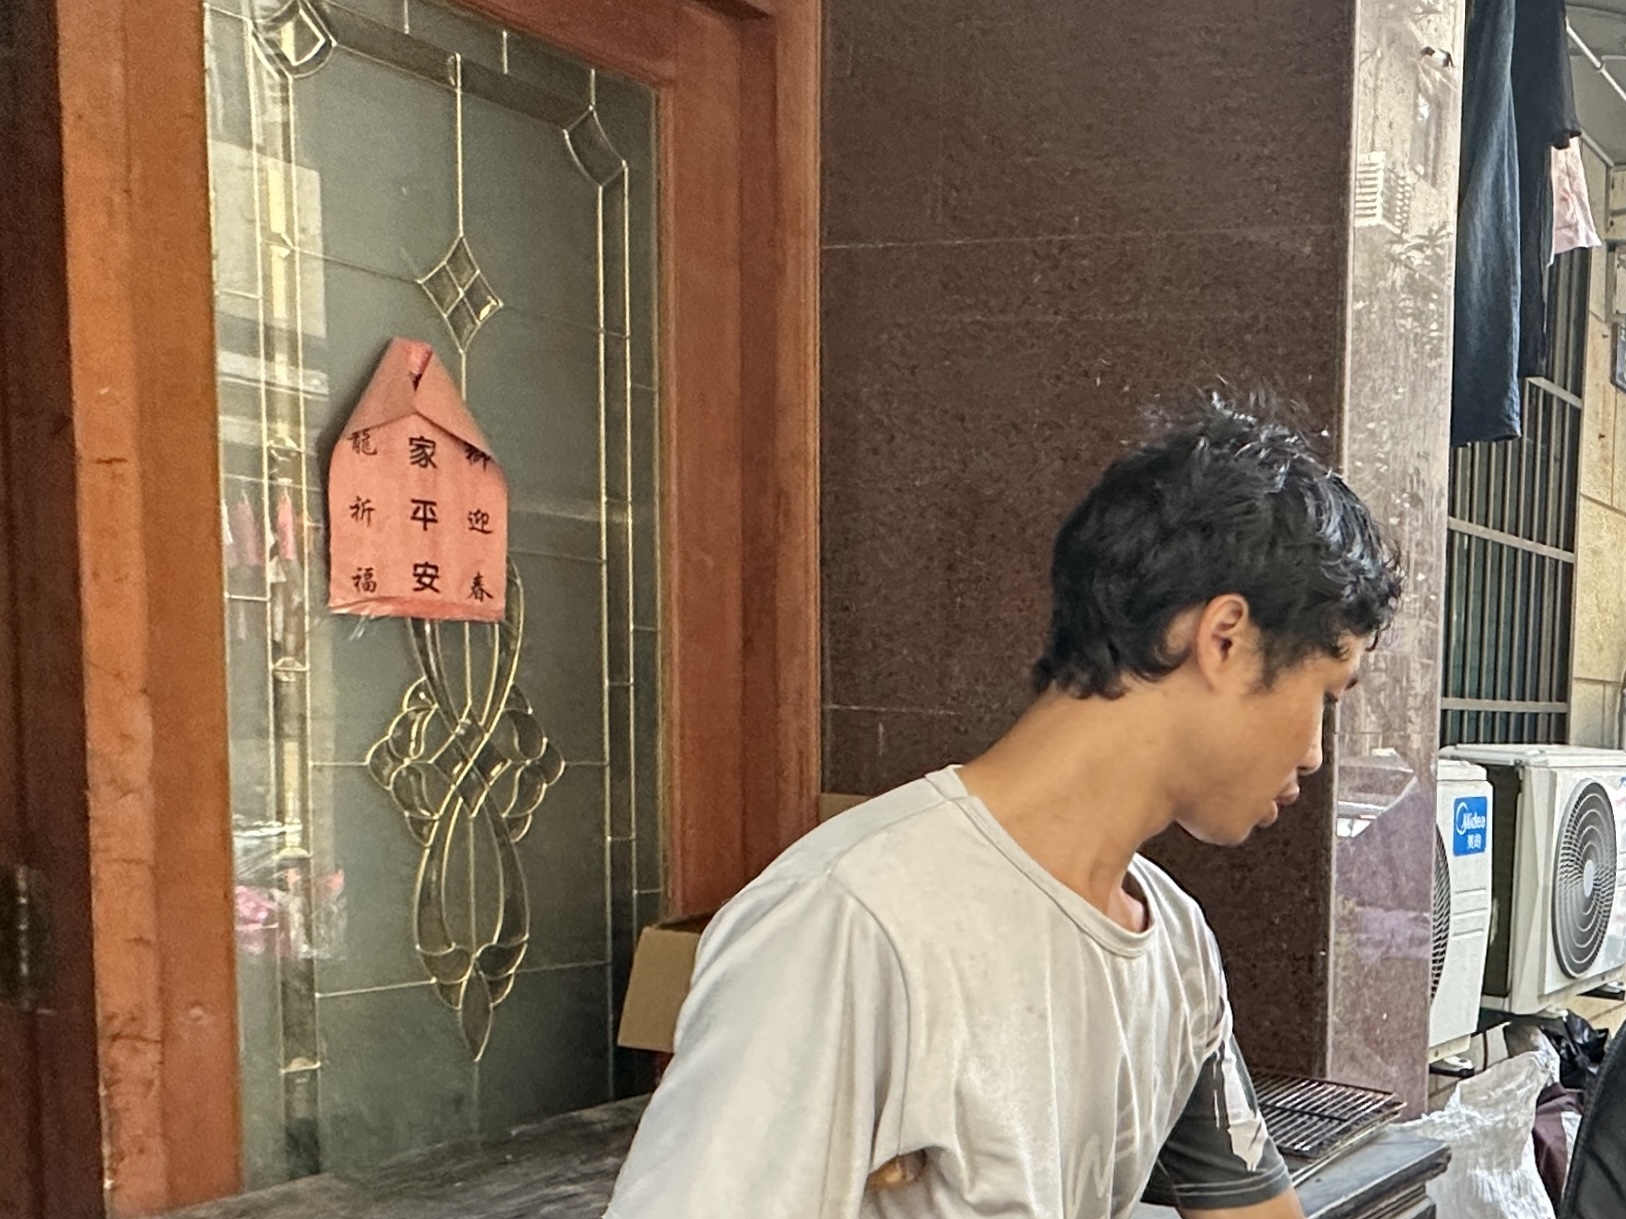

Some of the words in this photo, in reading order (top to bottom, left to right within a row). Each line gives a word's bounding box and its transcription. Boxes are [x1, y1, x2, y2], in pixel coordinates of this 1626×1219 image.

[408, 436, 441, 593] 家平安
[1456, 802, 1485, 835] Midea
